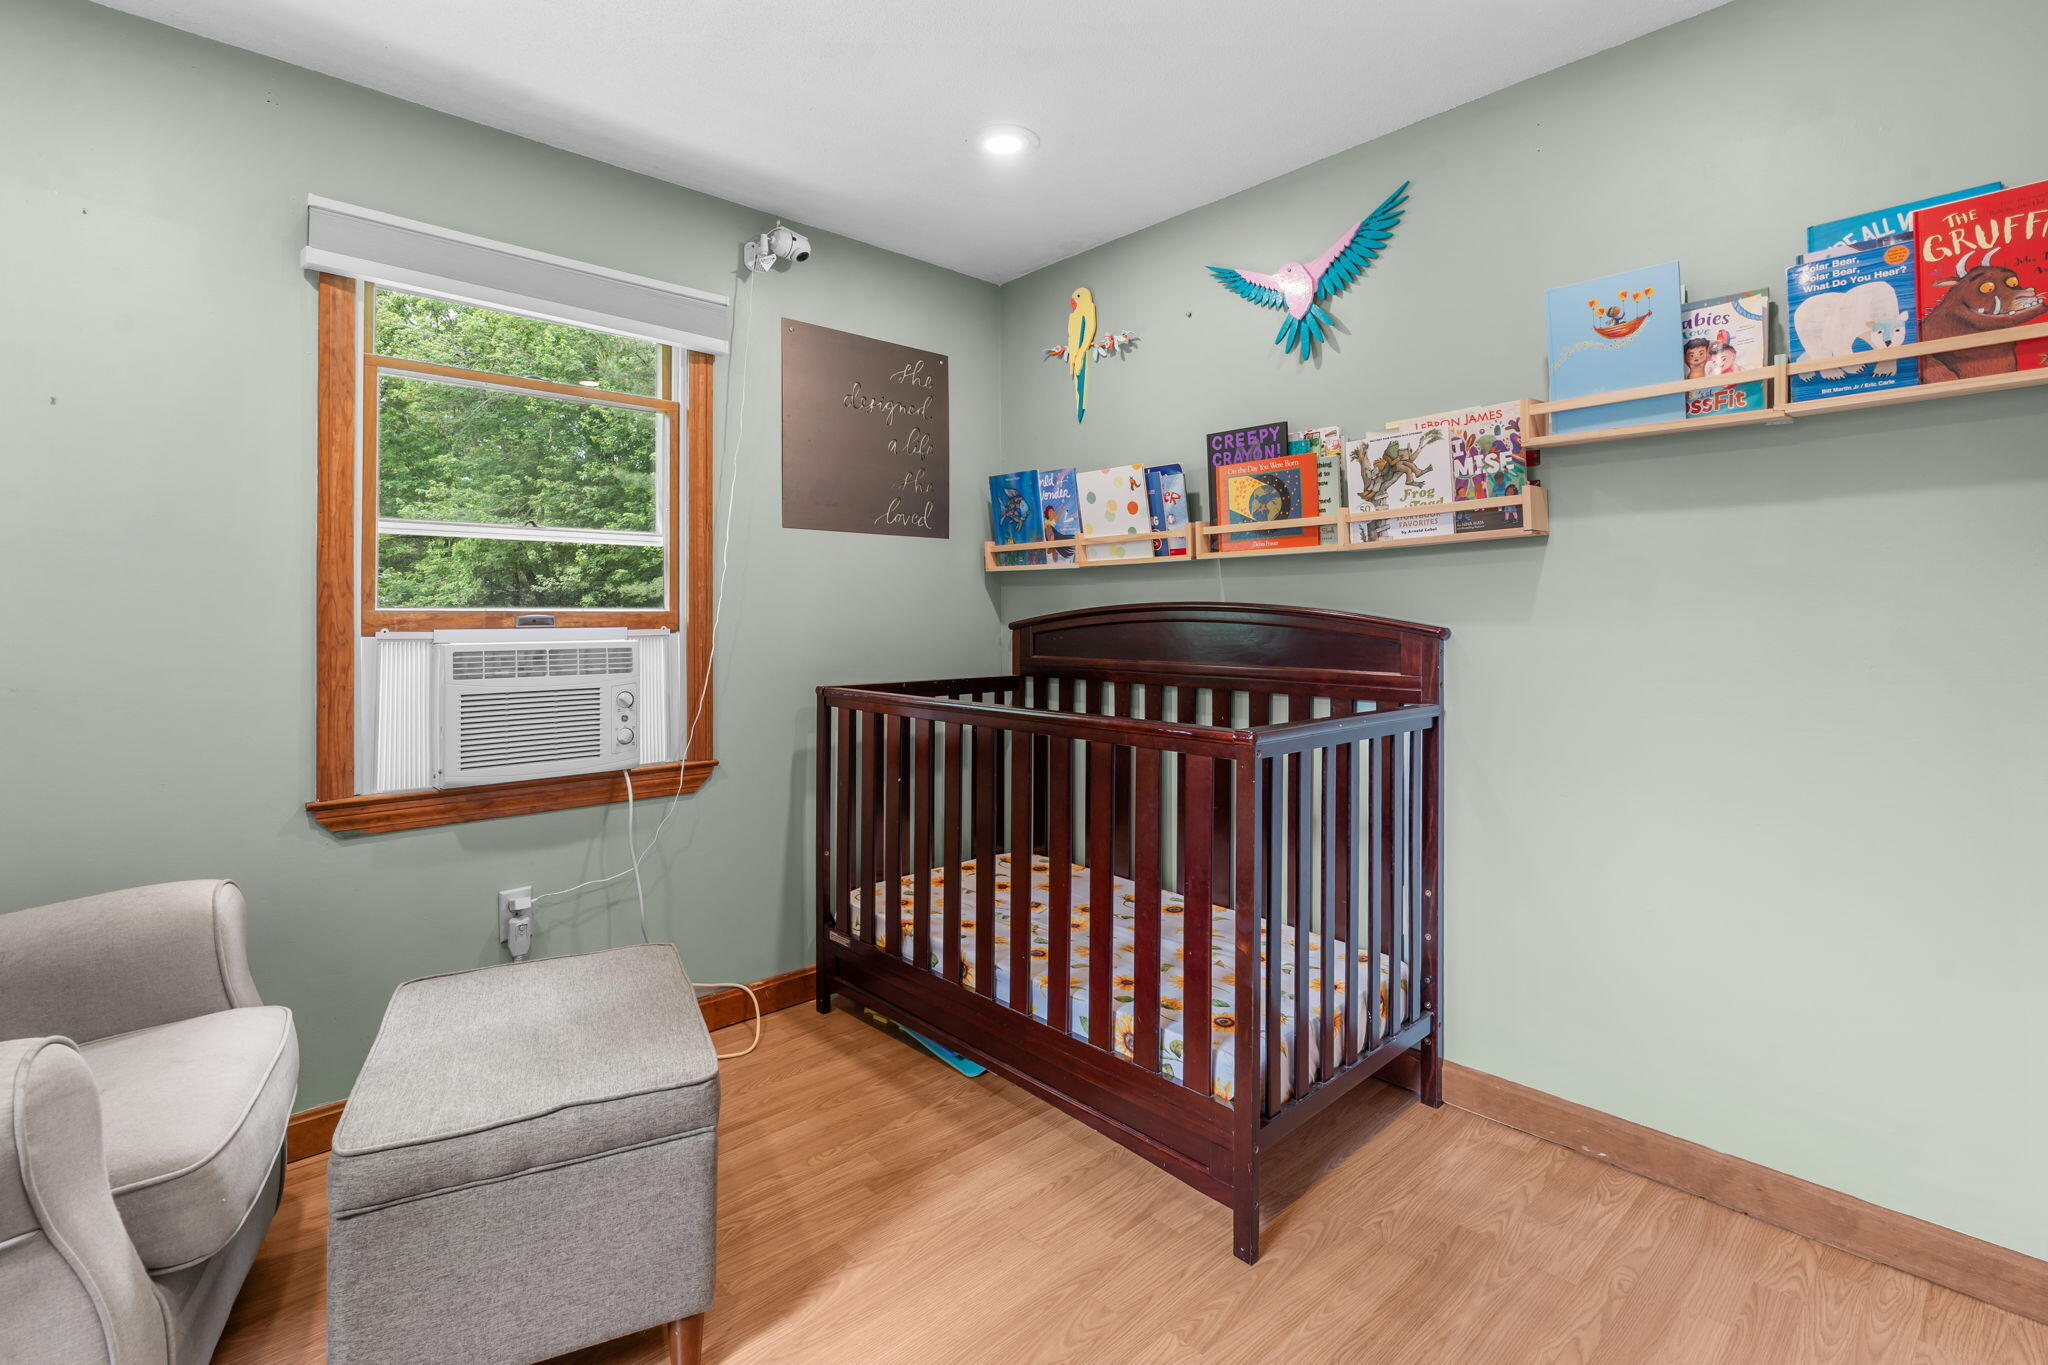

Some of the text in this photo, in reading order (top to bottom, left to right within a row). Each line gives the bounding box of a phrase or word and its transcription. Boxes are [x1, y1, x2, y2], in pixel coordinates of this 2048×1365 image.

[1942, 209, 1978, 228] THE
[1861, 218, 1896, 242] ALL
[1923, 209, 2048, 262] GRUFF
[1832, 257, 1859, 267] Bear,
[1833, 267, 1860, 277] Bear,
[1803, 266, 1907, 293] What Do You Hear?
[1682, 313, 1730, 330] abies
[1464, 410, 1502, 426] JAMES
[888, 427, 933, 461] a life
[1212, 426, 1279, 450] CREEPY
[1212, 444, 1280, 466] CRAYON!
[1400, 488, 1435, 502] Frog
[874, 497, 933, 529] loved
[1399, 518, 1438, 528] FAVORITES
